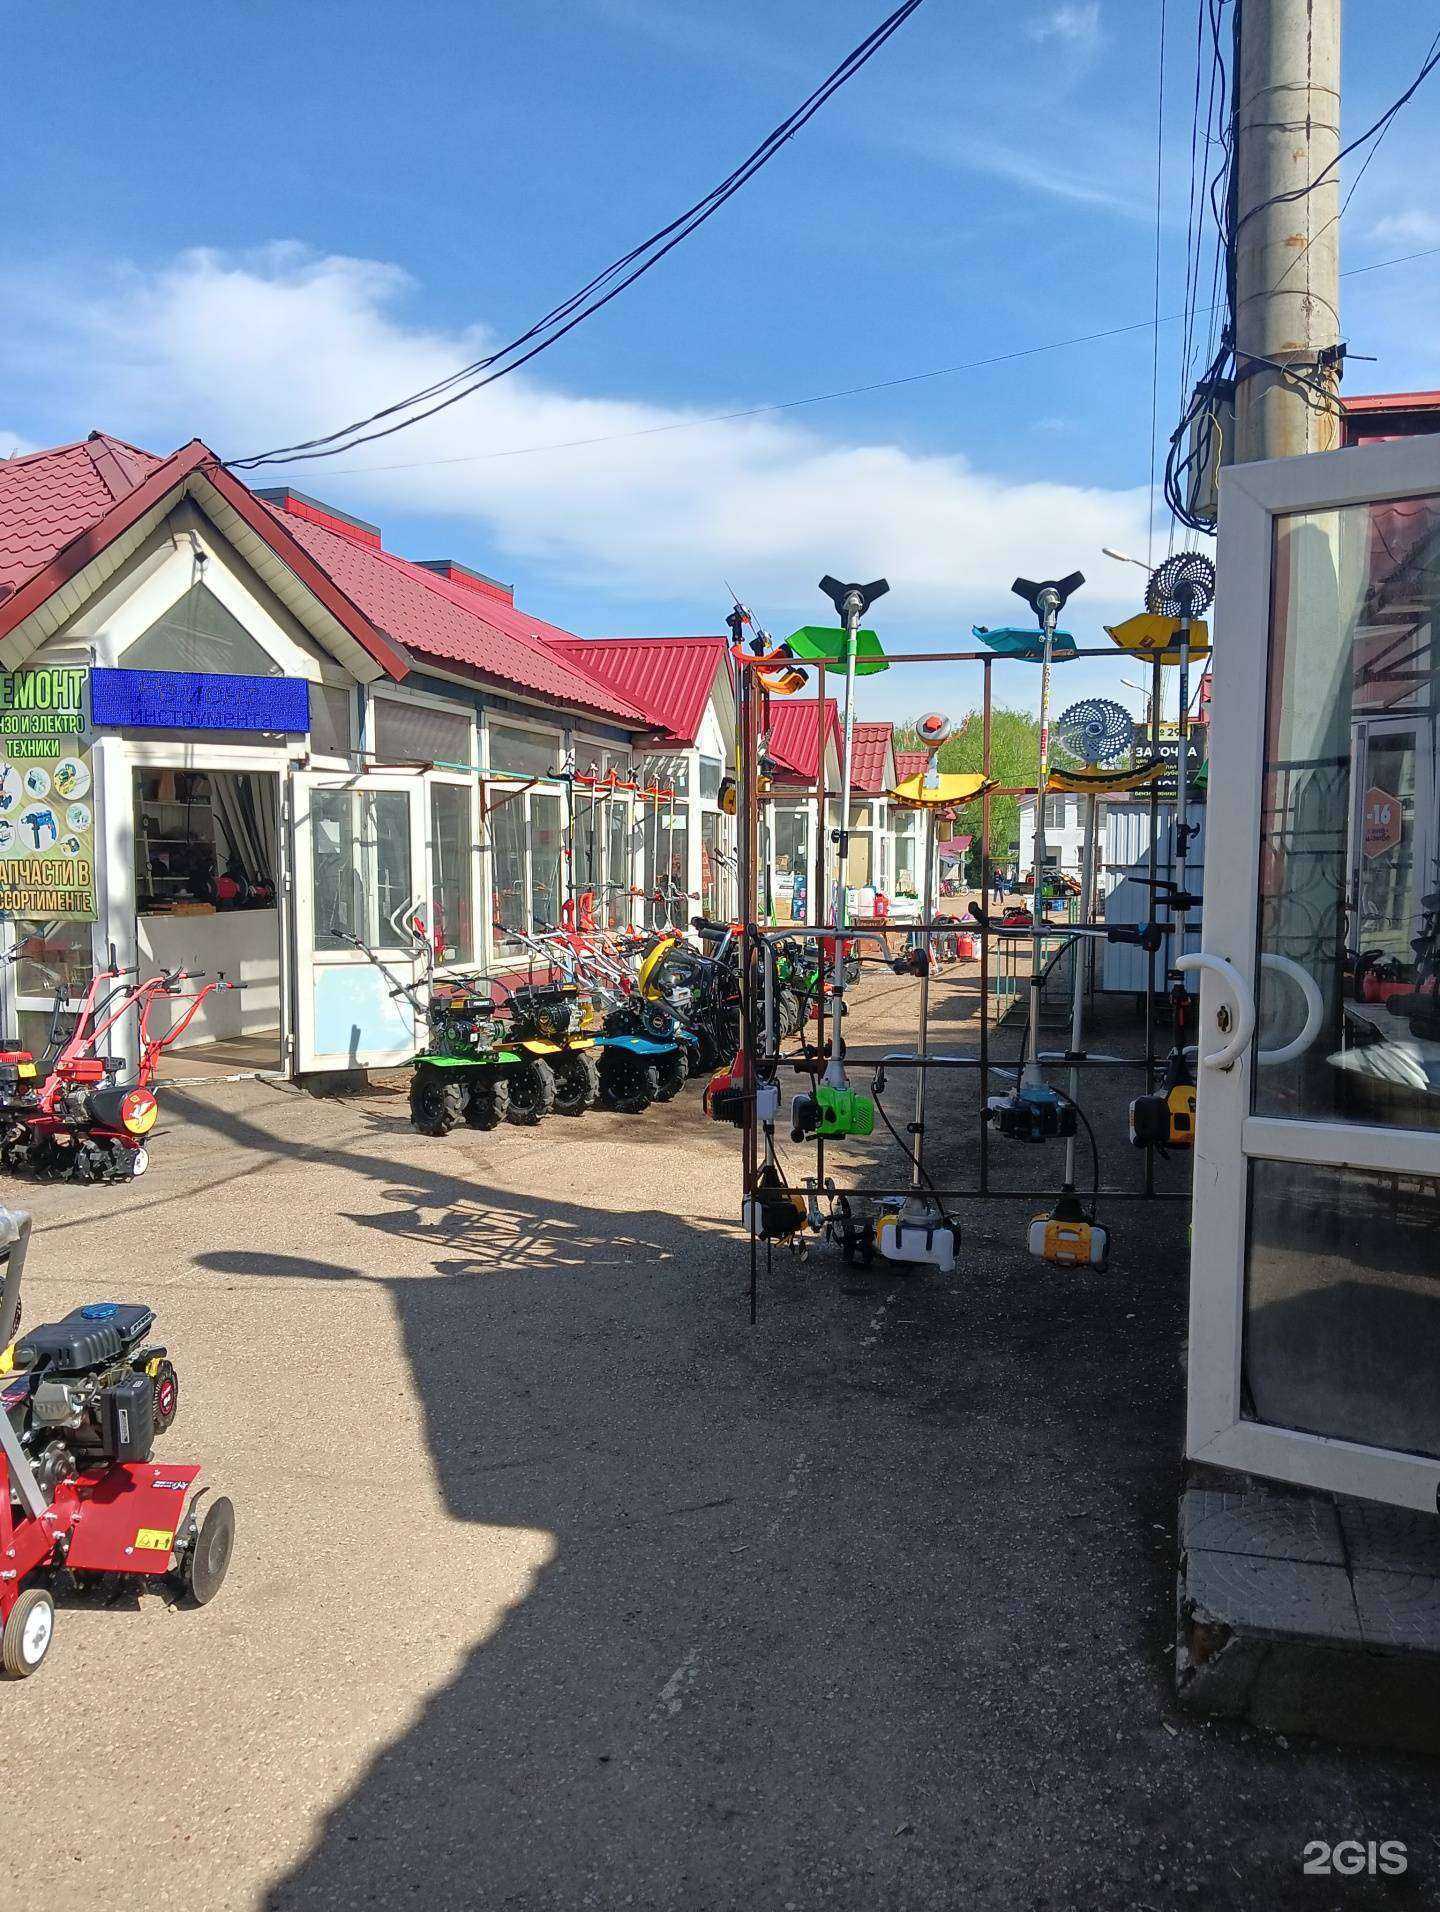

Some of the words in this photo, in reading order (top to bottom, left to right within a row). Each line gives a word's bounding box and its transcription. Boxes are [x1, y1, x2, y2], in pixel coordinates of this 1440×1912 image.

[21, 714, 31, 734] И
[31, 714, 85, 733] ЭЛЕКТРО
[6, 739, 60, 757] ТЕХНИКИ
[1135, 746, 1198, 757] ЗАОЧА
[0, 860, 74, 886] АПЧАСТИ
[78, 860, 91, 886] В
